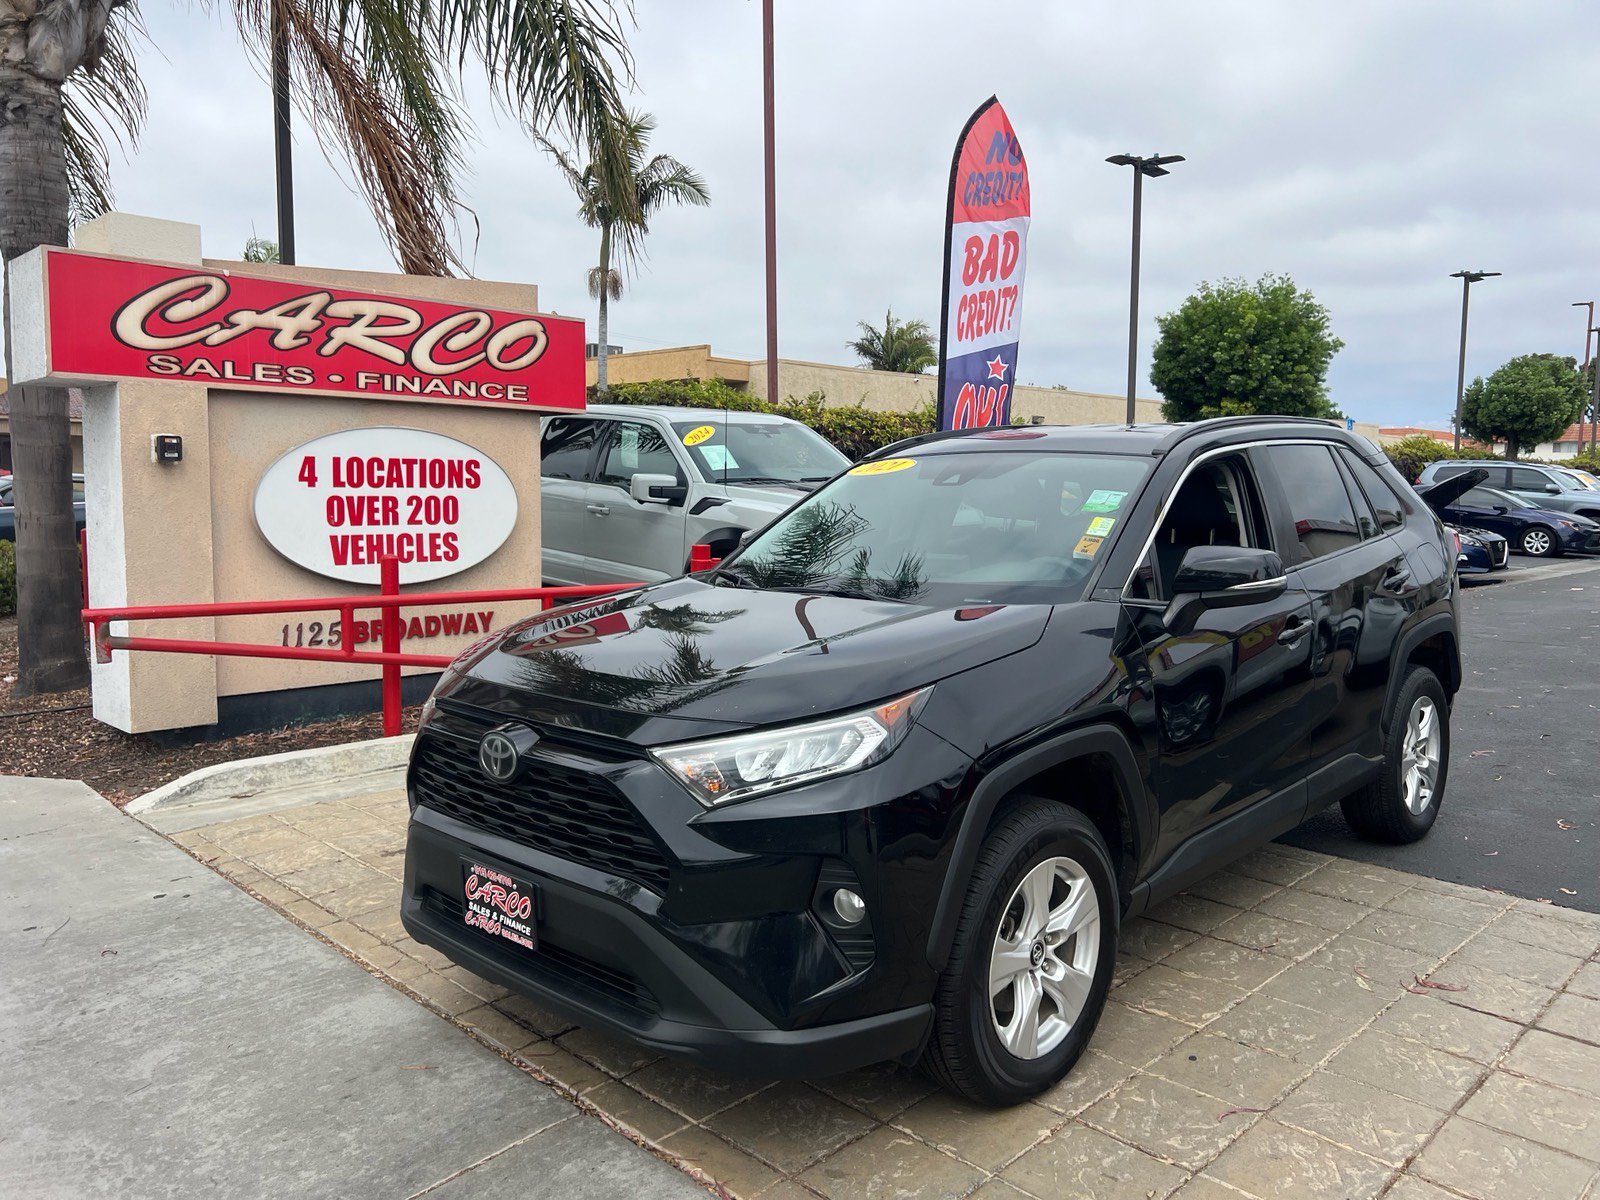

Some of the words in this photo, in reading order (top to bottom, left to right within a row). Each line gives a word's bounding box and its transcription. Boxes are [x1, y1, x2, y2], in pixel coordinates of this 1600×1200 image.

[986, 130, 1024, 166] NO
[963, 171, 1024, 208] CREDIT?
[962, 230, 1019, 286] BAD
[111, 275, 549, 375] CARCO
[957, 285, 1019, 342] CREDIT?
[146, 354, 315, 385] SALES
[356, 370, 529, 402] FINANCE
[688, 428, 710, 443] 2024
[298, 456, 318, 488] 4
[332, 456, 481, 489] LOCATIONS
[326, 495, 399, 527] OVER
[406, 495, 459, 525] 200
[329, 532, 460, 566] VEHICLES
[282, 621, 341, 648] 1125
[465, 874, 532, 919] CARCO
[465, 910, 501, 935] CARCO
[468, 901, 491, 917] SALES
[491, 911, 498, 921] &
[499, 914, 532, 936] FINANCE
